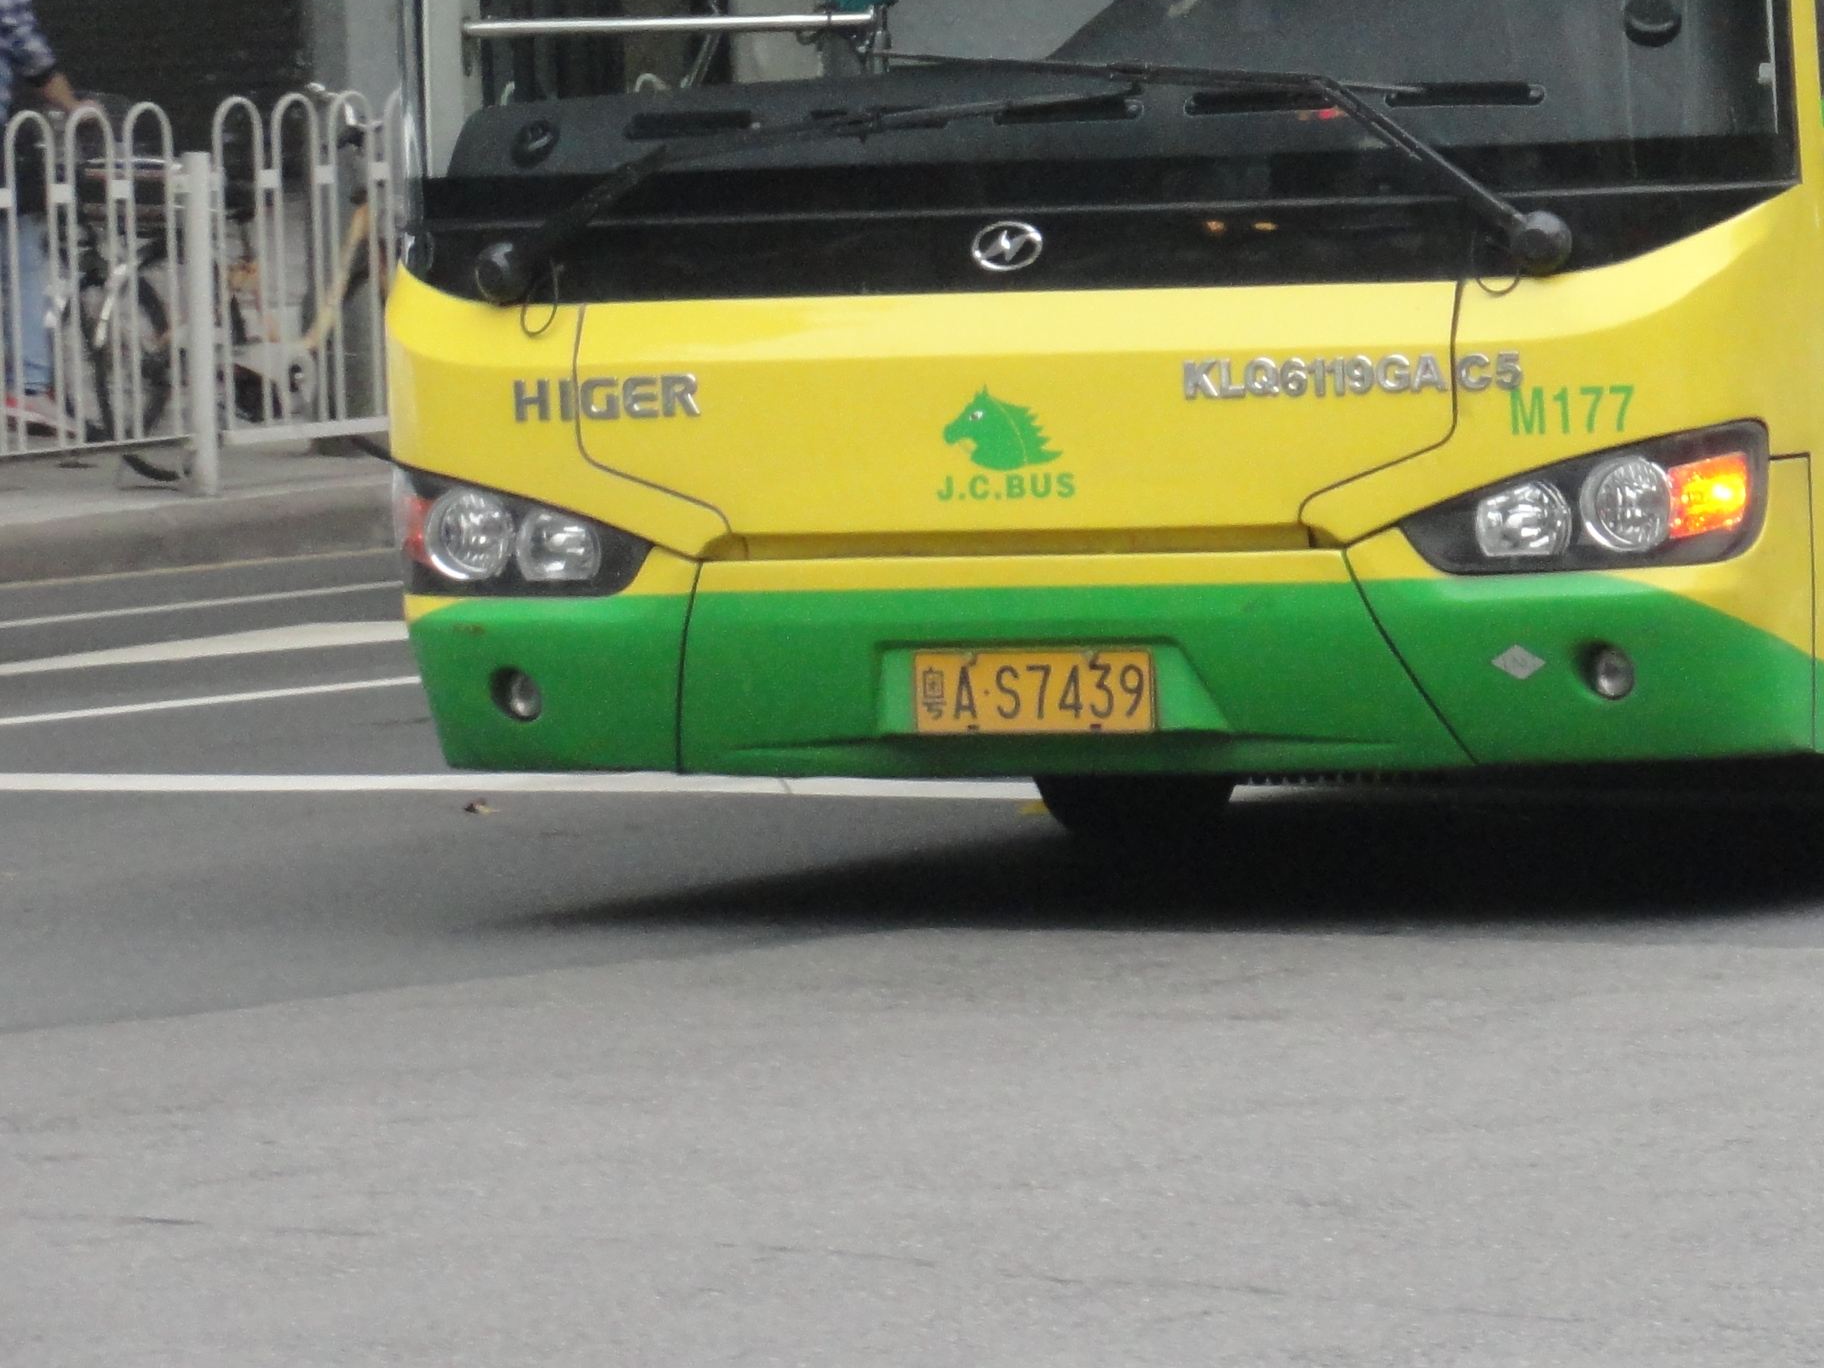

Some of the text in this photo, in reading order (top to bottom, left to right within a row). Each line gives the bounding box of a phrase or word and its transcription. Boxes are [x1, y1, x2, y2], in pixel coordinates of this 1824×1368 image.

[513, 373, 702, 423] HIGER
[1510, 384, 1636, 436] M177
[936, 472, 1078, 501] J.C.BUS
